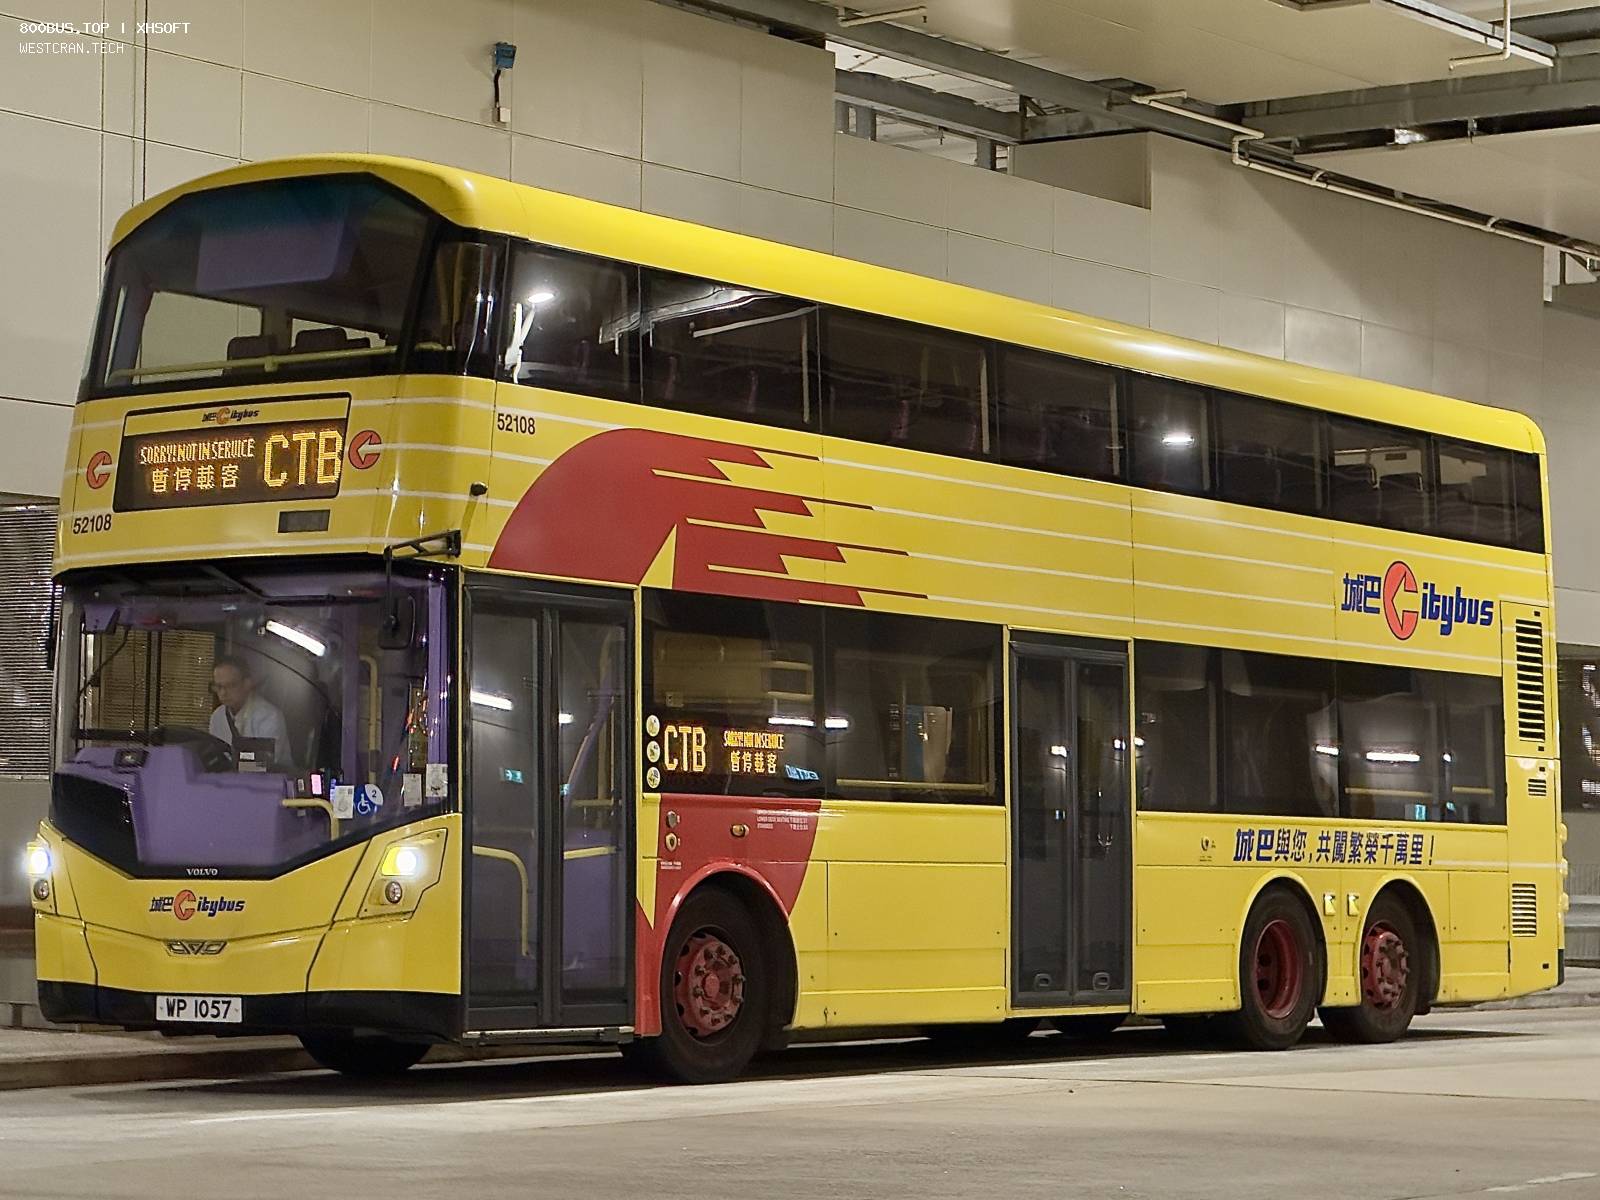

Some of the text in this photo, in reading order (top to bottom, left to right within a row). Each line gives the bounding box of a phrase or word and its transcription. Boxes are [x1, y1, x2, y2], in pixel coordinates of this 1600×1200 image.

[497, 413, 536, 435] 52108
[178, 443, 198, 462] NOT
[199, 442, 210, 460] IN
[212, 438, 256, 460] SERVICE
[263, 430, 343, 488] CTB
[72, 513, 112, 535] 52108
[1341, 573, 1382, 615] 城巴
[1383, 560, 1494, 641] Citybus
[663, 725, 707, 772] CTB
[371, 789, 378, 799] 2
[186, 868, 218, 876] VOLVO
[173, 889, 246, 921] Citybus
[166, 998, 232, 1019] WP 1057
